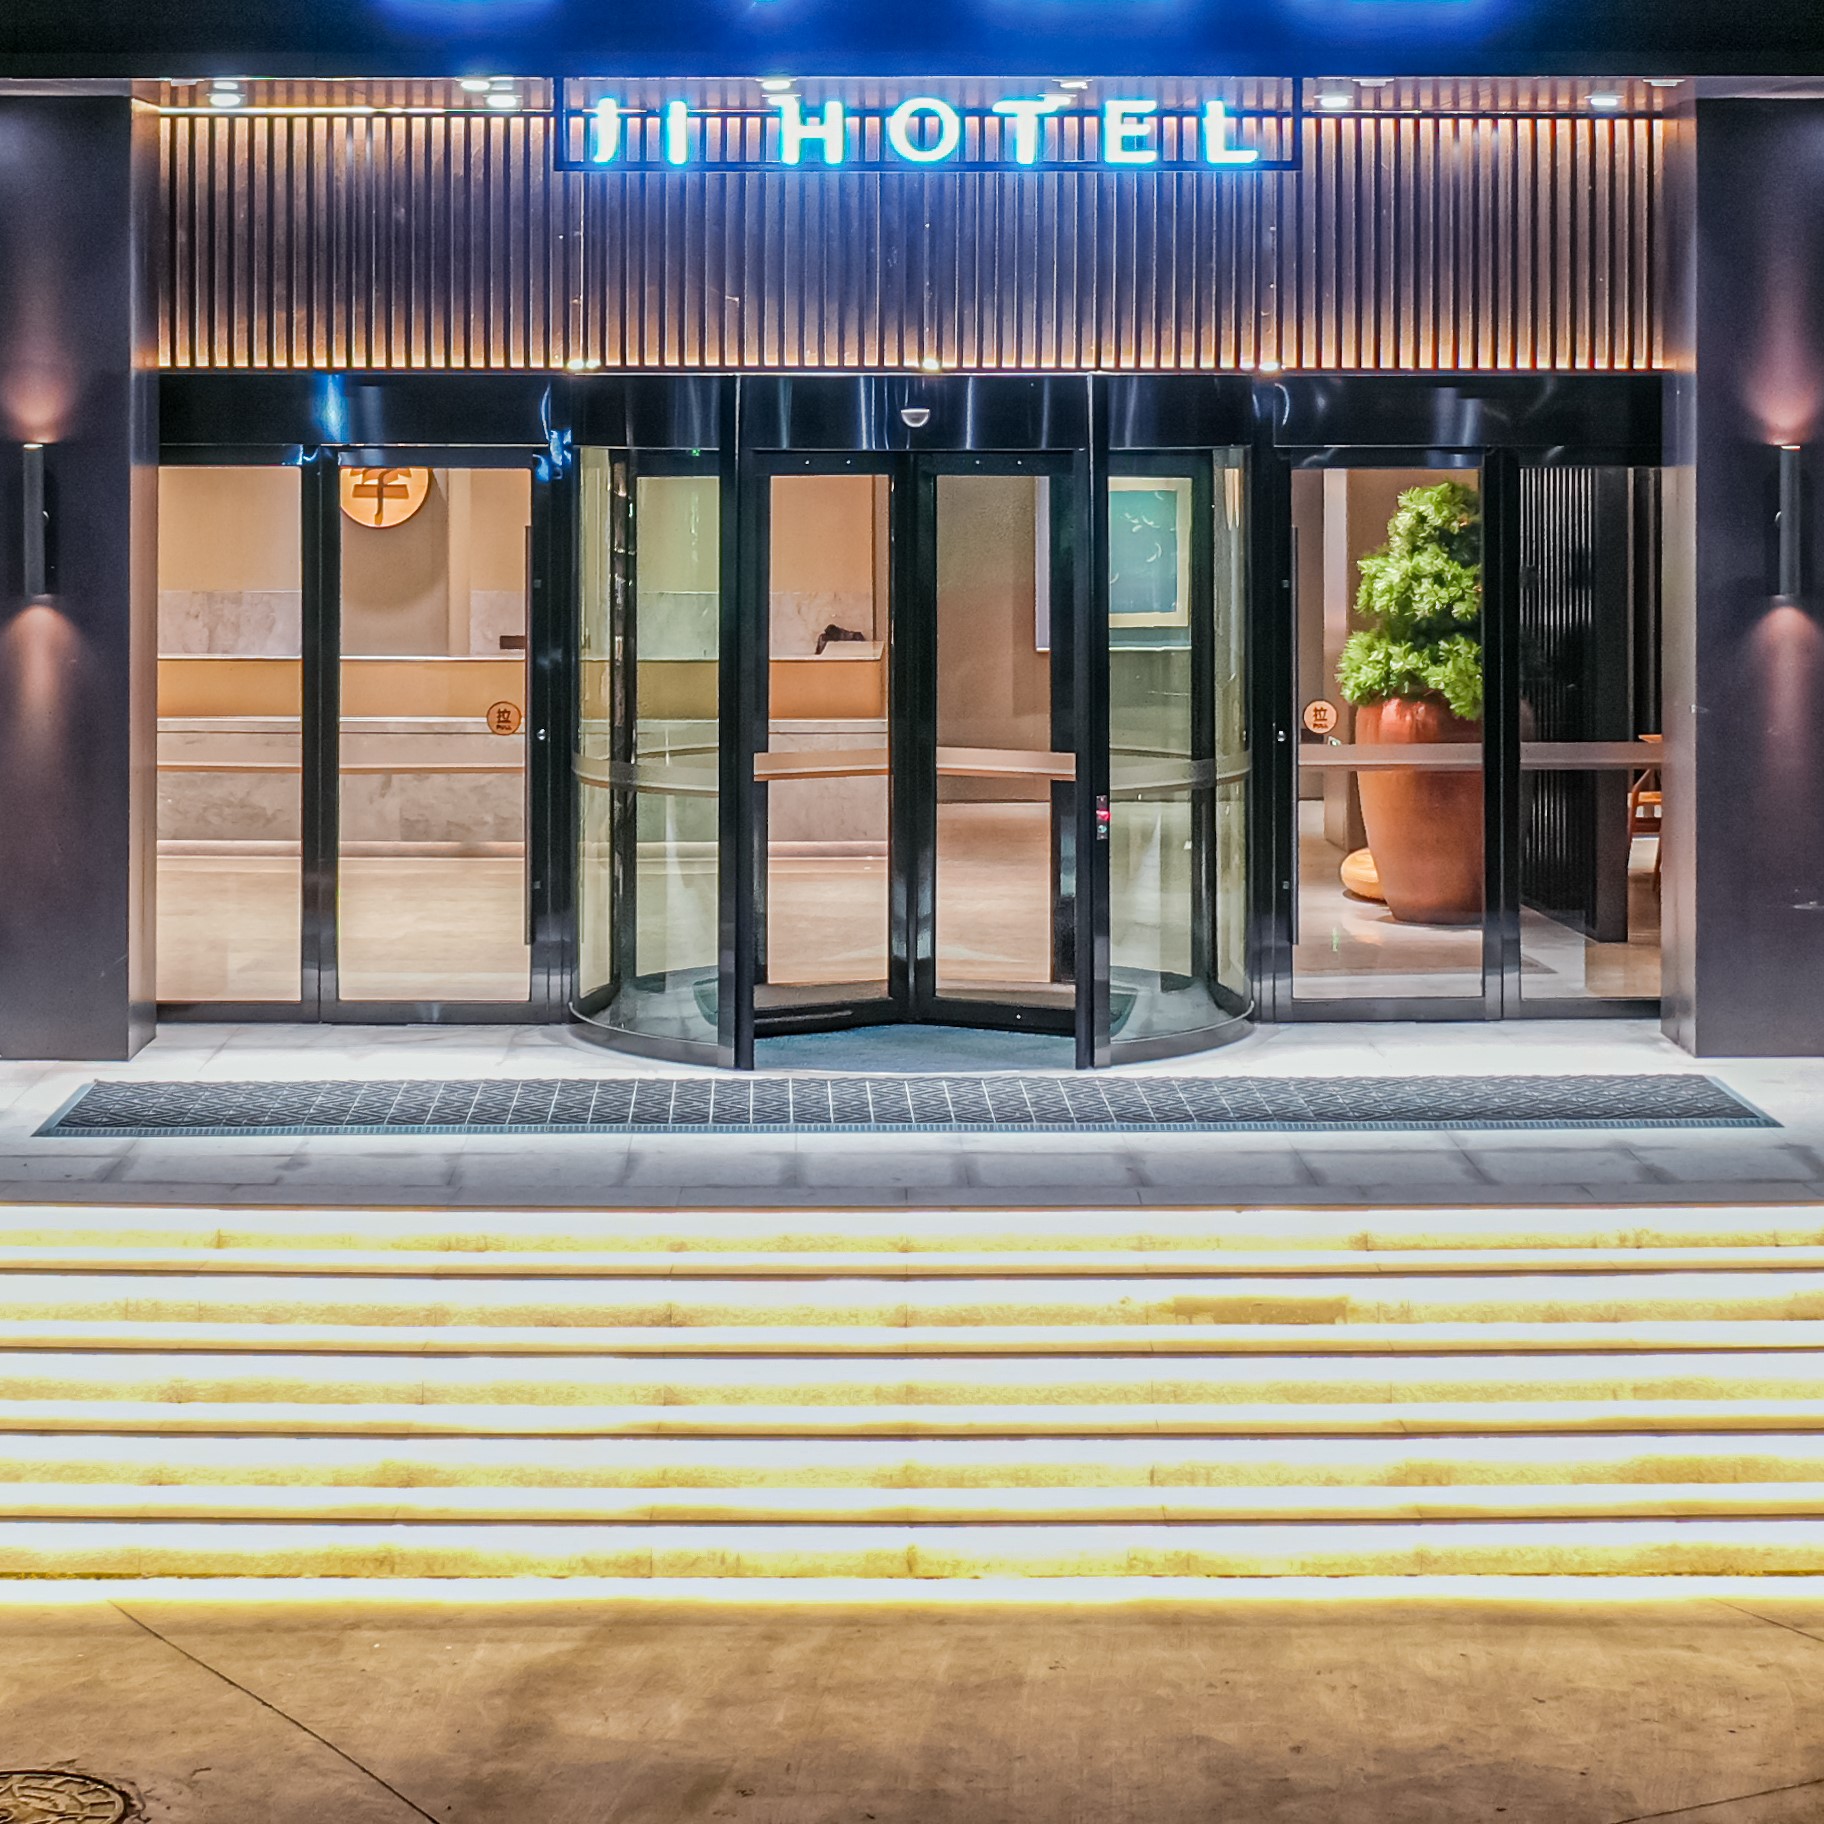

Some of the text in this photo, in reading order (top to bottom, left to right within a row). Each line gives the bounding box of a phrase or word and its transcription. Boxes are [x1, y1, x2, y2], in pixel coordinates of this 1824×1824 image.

[591, 96, 1259, 166] JI HOTEL
[496, 708, 512, 724] 拉
[1313, 706, 1328, 722] 拉
